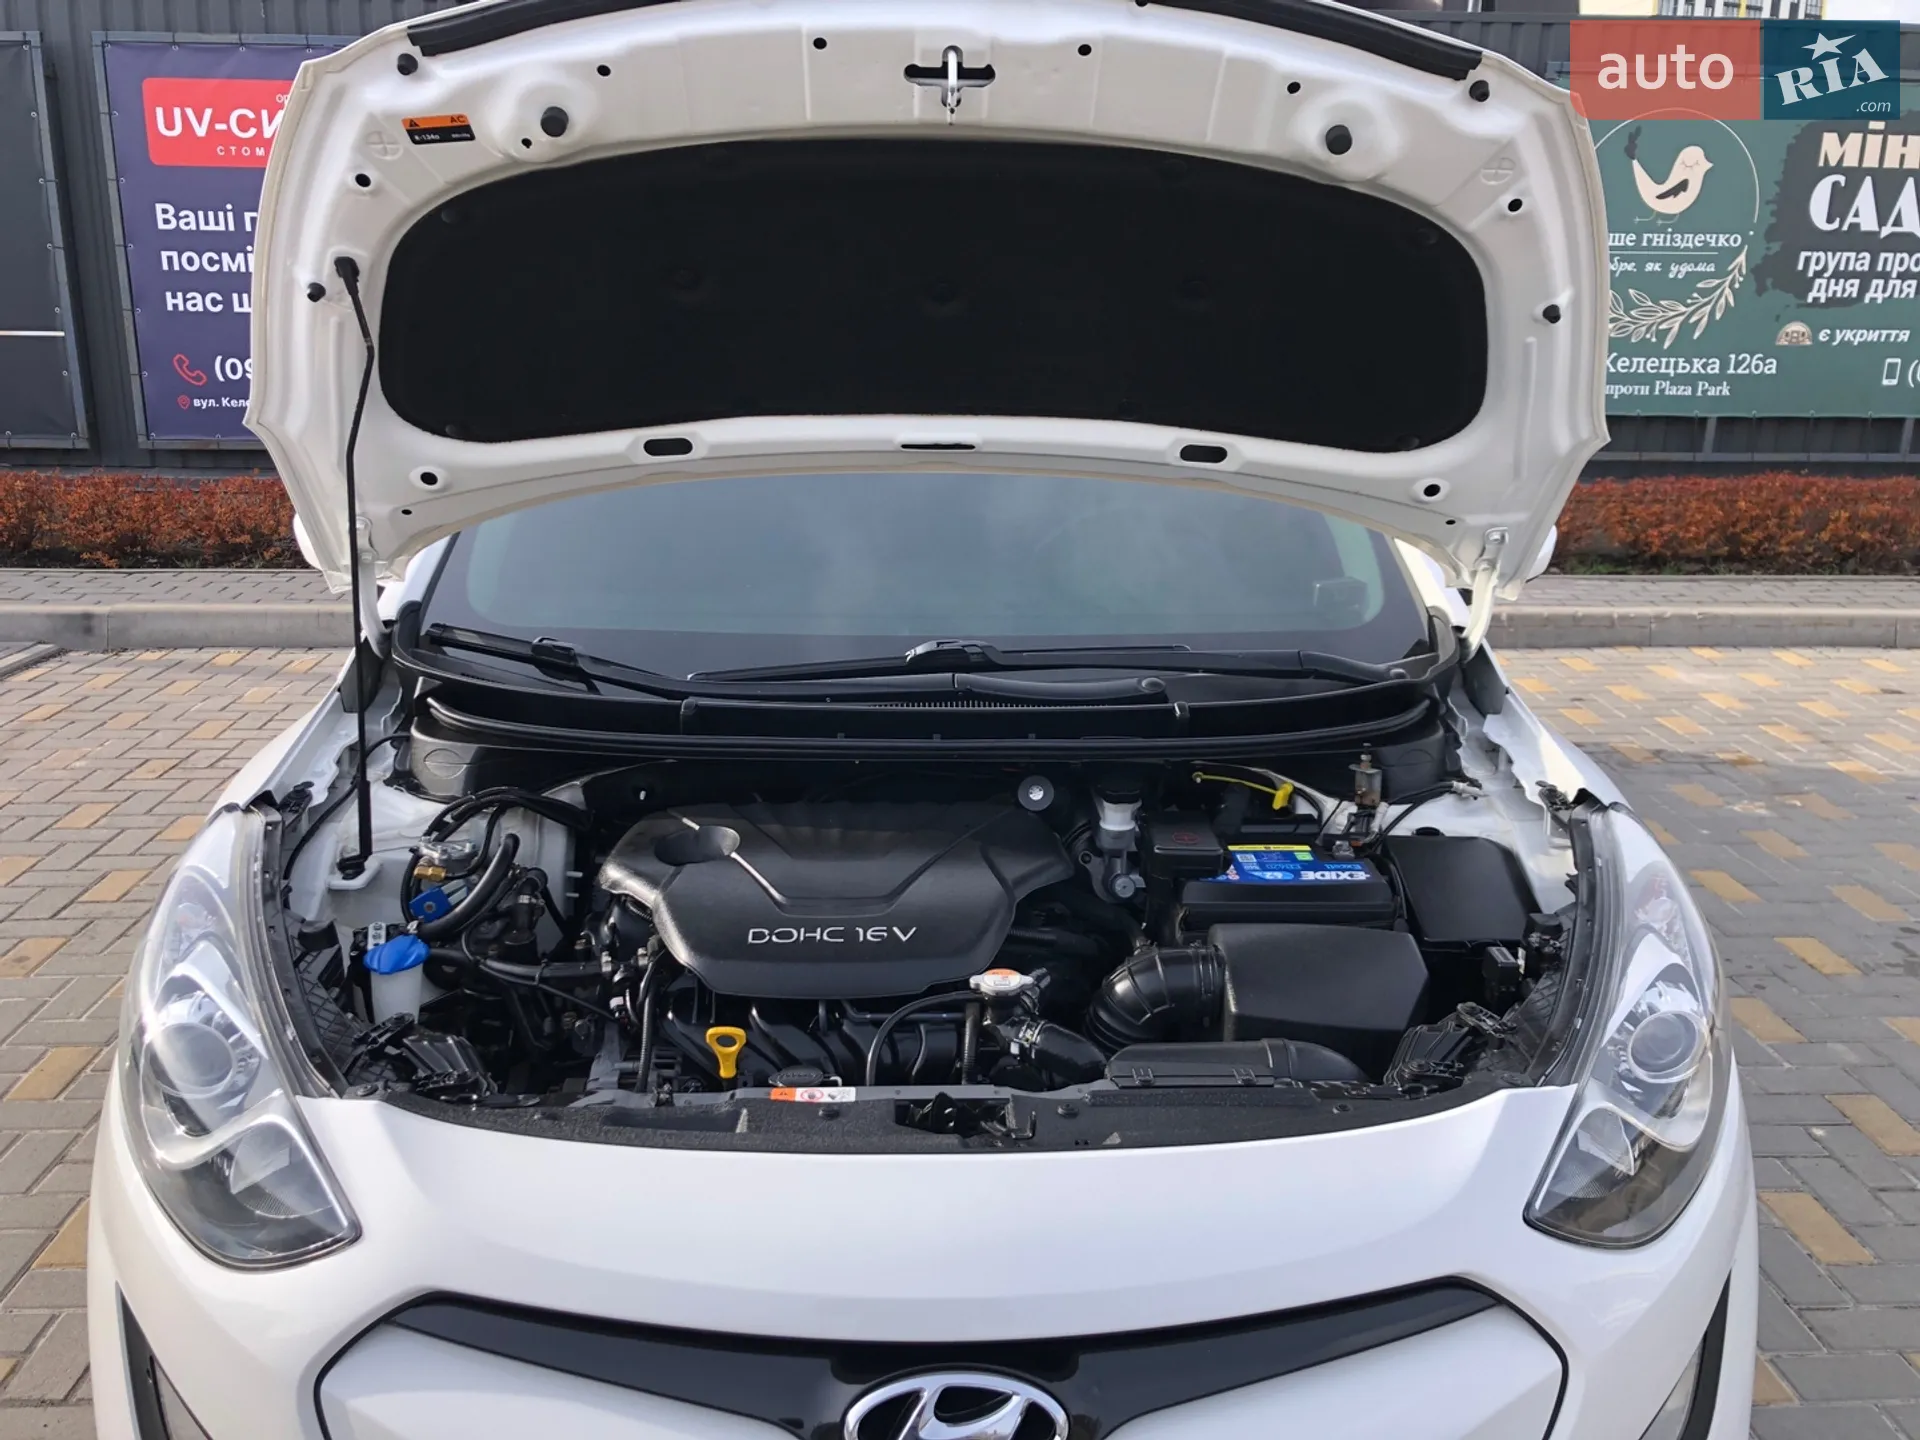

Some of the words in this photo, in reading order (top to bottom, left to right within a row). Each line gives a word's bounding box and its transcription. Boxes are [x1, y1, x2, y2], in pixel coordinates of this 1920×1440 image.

[154, 203, 235, 232] Ваші
[1809, 174, 1920, 239] САД
[1641, 227, 1742, 249] гніздечко
[161, 245, 253, 273] посмі
[1609, 256, 1637, 277] бре,
[1797, 251, 1870, 277] група
[166, 290, 224, 312] нас
[1807, 277, 1860, 304] дня
[1865, 278, 1916, 304] для
[1832, 328, 1911, 345] укриття
[1605, 352, 1720, 377] Келецька
[1654, 380, 1692, 396] Plaza
[1696, 381, 1731, 396] Park
[193, 397, 220, 409] вул.
[1301, 871, 1370, 880] EXIDE
[747, 926, 845, 944] DOHC
